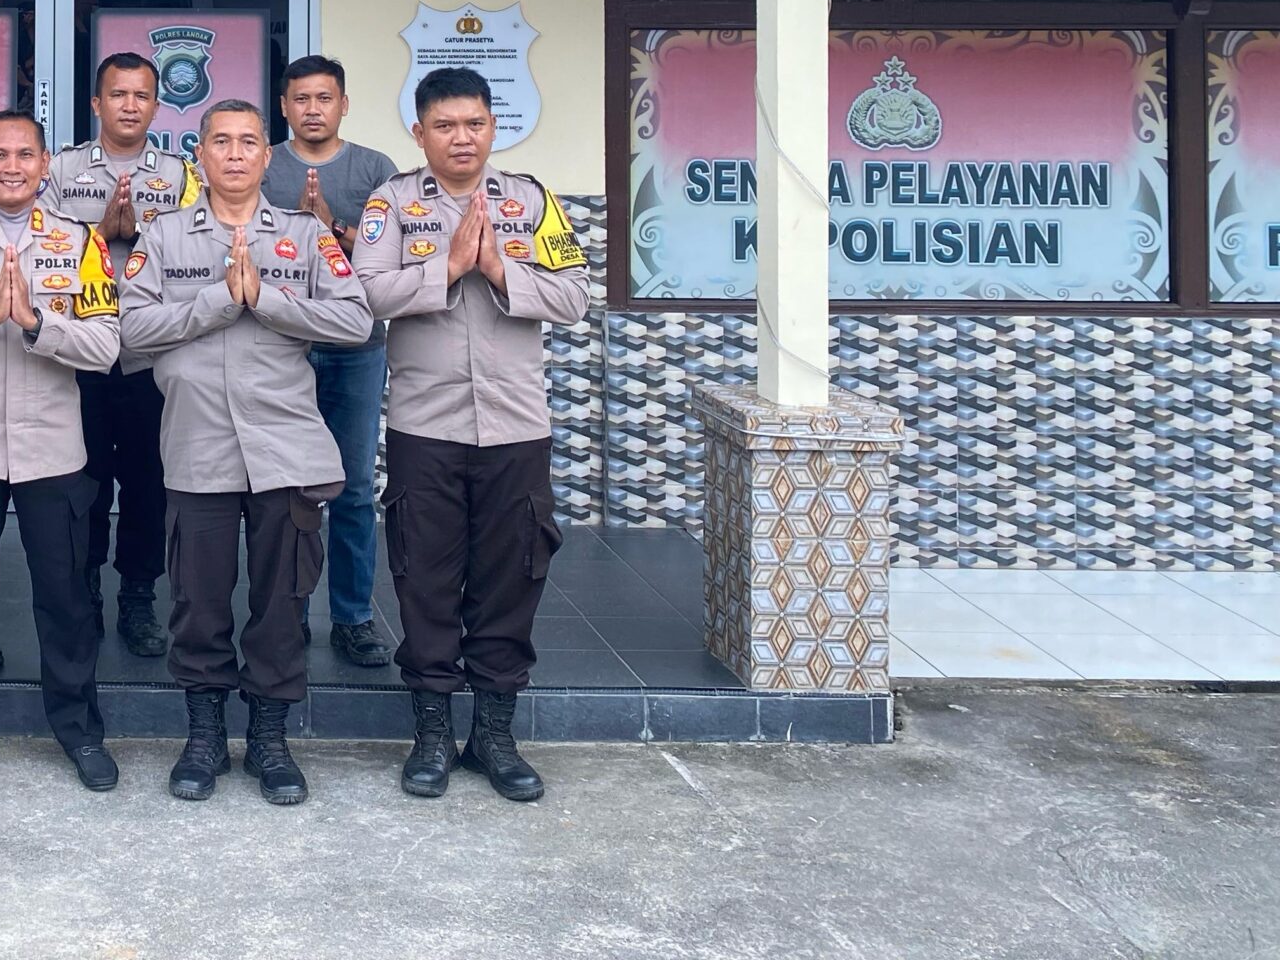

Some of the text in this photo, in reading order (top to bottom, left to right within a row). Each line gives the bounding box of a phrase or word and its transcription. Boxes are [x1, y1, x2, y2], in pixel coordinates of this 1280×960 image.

[154, 30, 209, 41] POLRES LANDAK
[40, 82, 48, 123] TARIK
[686, 159, 1110, 206] SENA PELAYANAN
[62, 188, 176, 205] SIAHAAN POLRI
[733, 219, 1061, 265] KOLISIAN
[34, 257, 78, 270] POLRI
[164, 267, 306, 281] TADUNG POLRI
